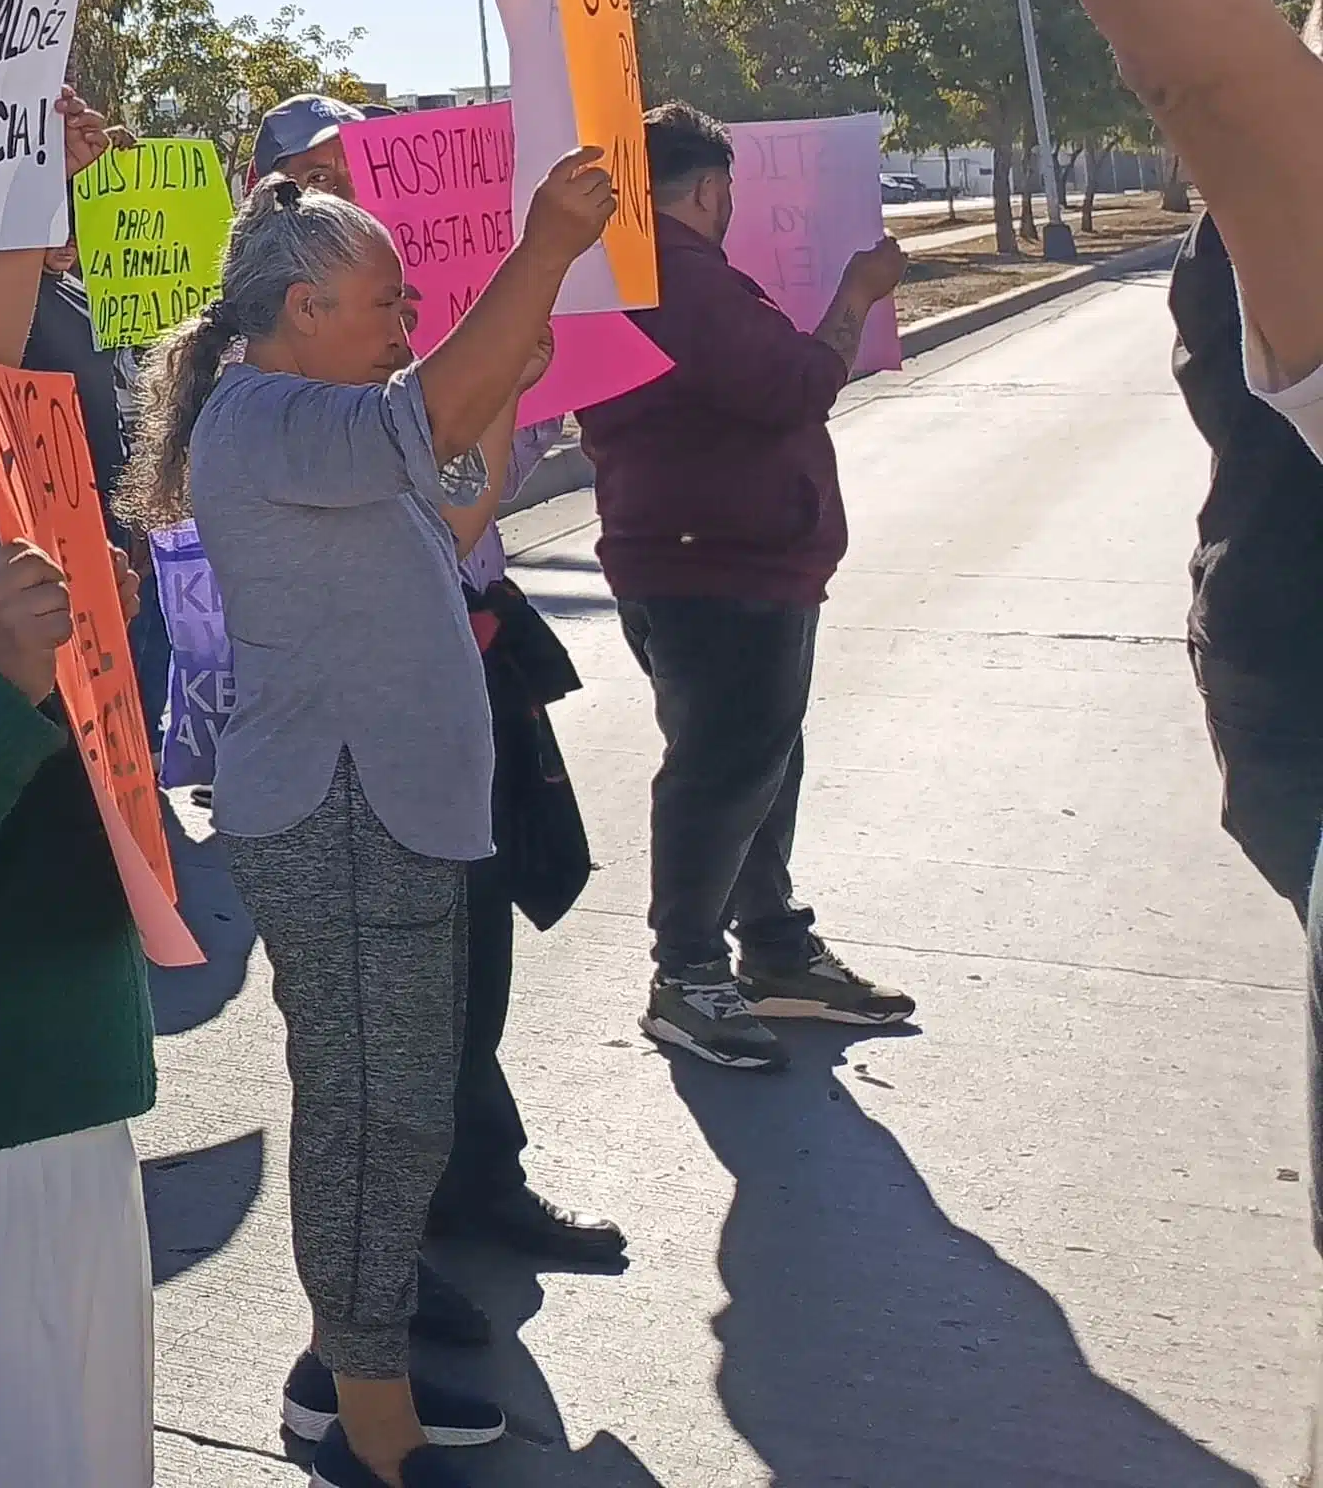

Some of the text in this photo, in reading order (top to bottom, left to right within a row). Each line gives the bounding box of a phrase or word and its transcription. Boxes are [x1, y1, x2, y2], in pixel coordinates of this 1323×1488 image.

[363, 127, 493, 199] HOSPITAL
[115, 208, 164, 241] PARA
[398, 212, 476, 267] BASTA
[90, 249, 114, 278] LA
